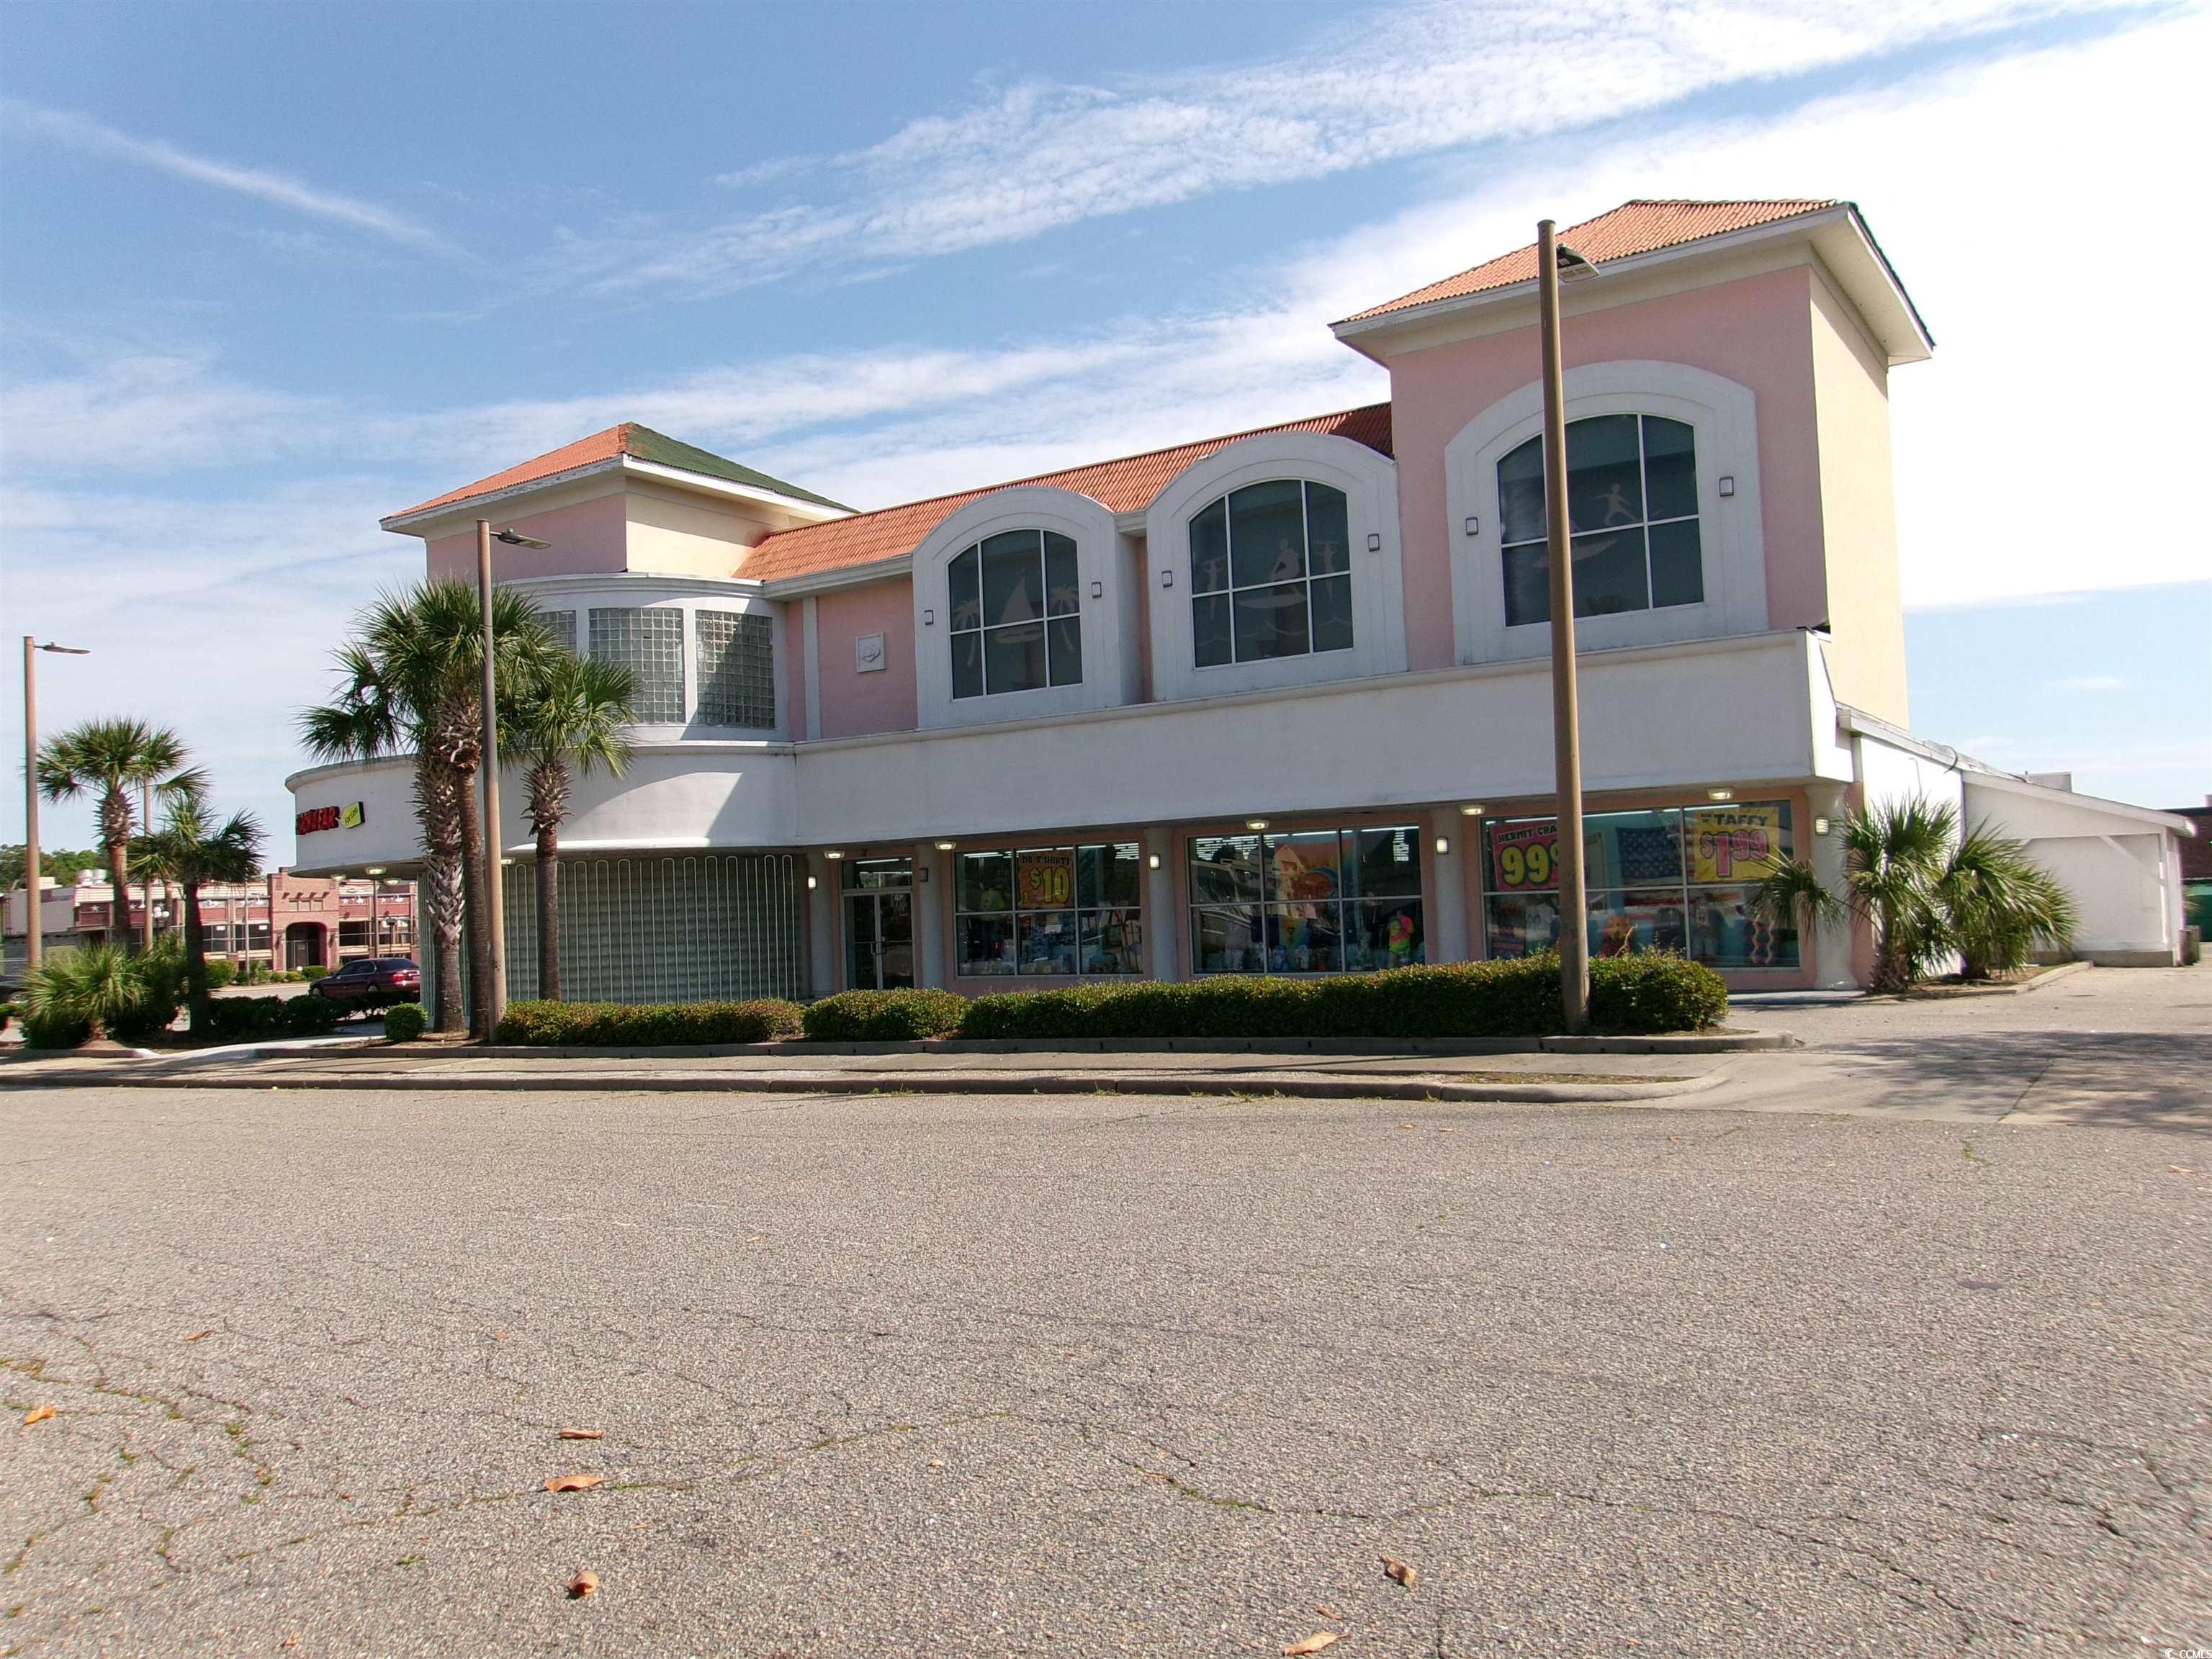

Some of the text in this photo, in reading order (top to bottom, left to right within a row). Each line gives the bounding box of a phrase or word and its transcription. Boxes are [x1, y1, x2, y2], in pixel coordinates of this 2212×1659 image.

[1713, 813, 1768, 826] TAFFY
[1498, 825, 1557, 842] HERMIT CRA
[1029, 864, 1071, 904] $10
